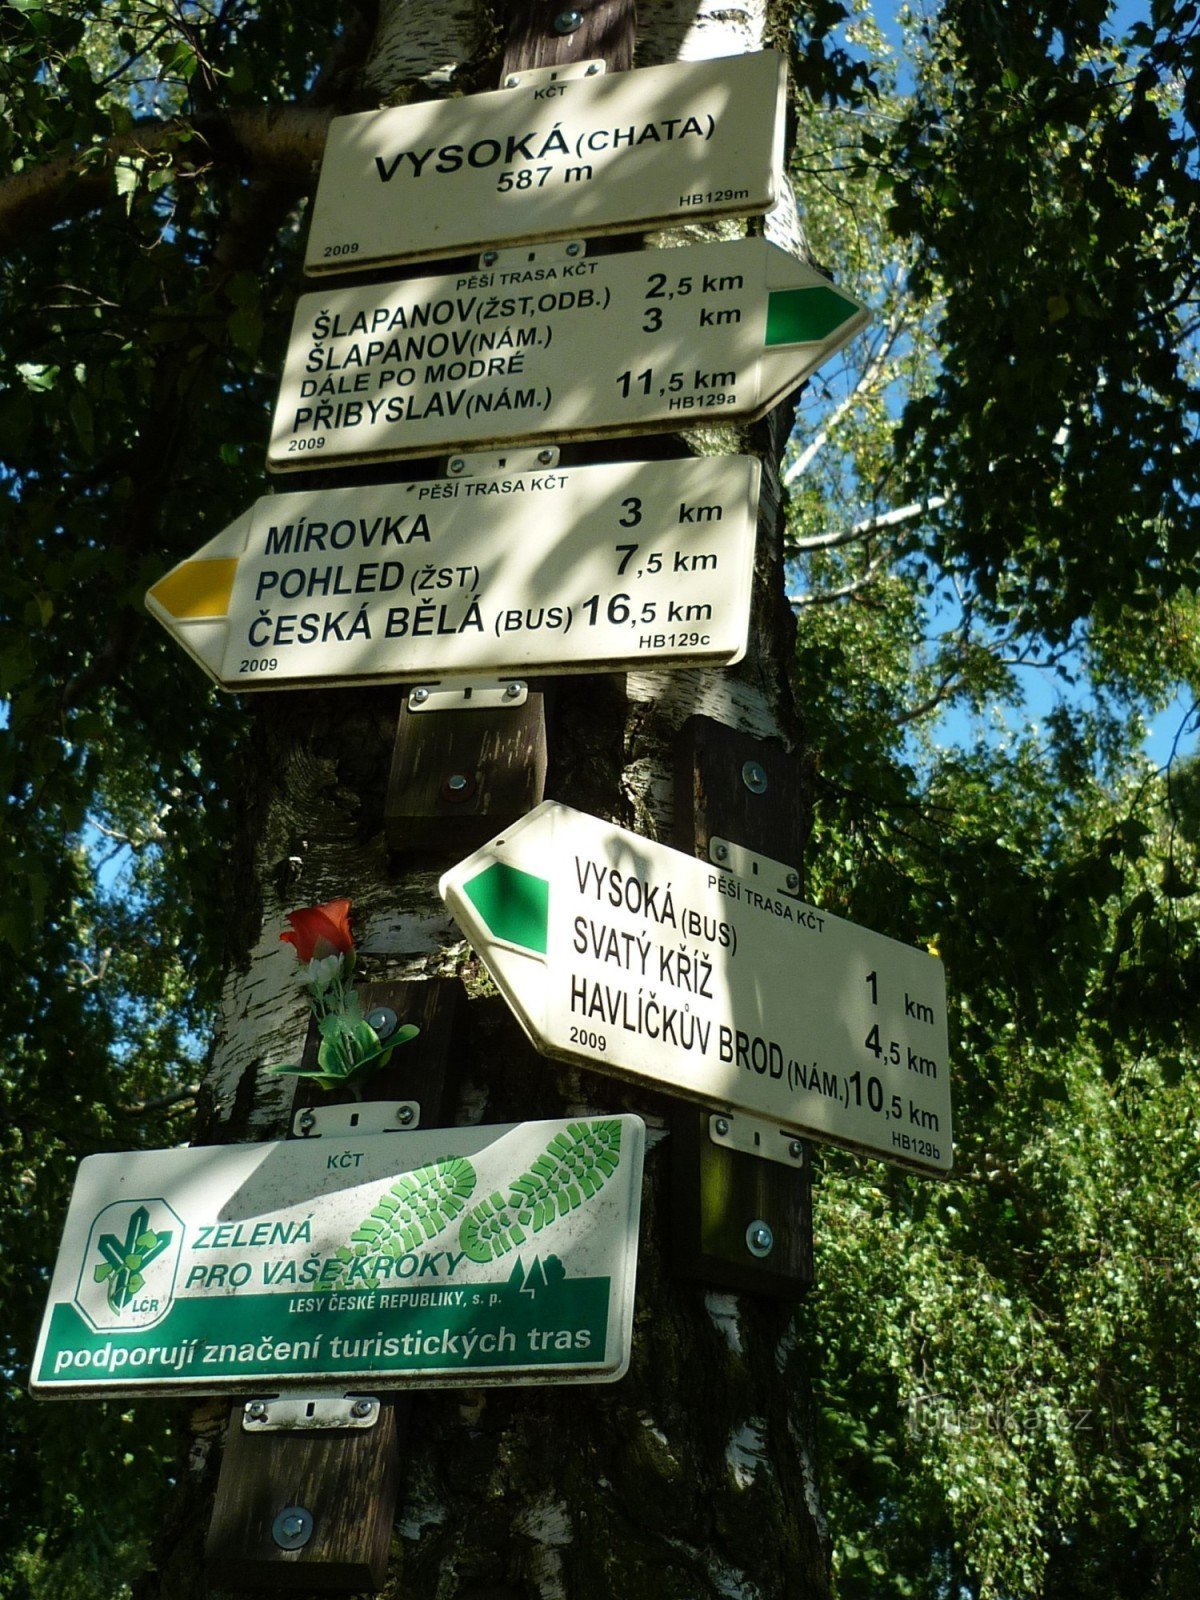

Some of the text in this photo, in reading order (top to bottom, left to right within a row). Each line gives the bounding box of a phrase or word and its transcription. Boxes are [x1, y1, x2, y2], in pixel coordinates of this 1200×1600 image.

[534, 85, 566, 100] KČT
[375, 122, 570, 183] VYSOKÁ
[497, 165, 592, 193] 587 m
[679, 188, 749, 207] HB129m
[324, 243, 359, 258] 2009
[456, 263, 598, 291] PĚŠÍ TRASA KČT
[645, 273, 743, 301] 2,5 km
[642, 307, 741, 333] 3 km
[300, 353, 525, 399] DÁLE PO MODRÉ
[616, 368, 736, 399] 11,5 km
[669, 393, 736, 411] HB129a
[288, 437, 325, 452] 2009
[418, 475, 569, 501] PĚŠÍ TRASA KČT
[618, 497, 723, 528] 3 km
[264, 513, 432, 556] MÍROVKA
[615, 543, 718, 579] 7,5 km
[255, 561, 480, 601] POHLED (ŽST)
[248, 594, 573, 648] ČESKÁ BĚLÁ (BUS)
[582, 592, 712, 628] 16,5 km
[638, 632, 711, 649] HB129c
[239, 658, 278, 673] 2009
[575, 855, 738, 957] VYSOKÁ (BUS)
[708, 874, 825, 933] PĚŠÍ TRASA KČT
[573, 916, 713, 999] SVATÝ KŘÍŽ
[865, 971, 934, 1025] 1 km
[570, 1026, 607, 1051] 2009
[571, 974, 711, 1055] HAVLÍČKŮV
[719, 1024, 784, 1080] BROD
[865, 1024, 937, 1079] 4,5 km
[849, 1070, 940, 1132] 10,5 km
[327, 1150, 364, 1169] KČT
[892, 1130, 941, 1160] HB129b
[191, 1213, 315, 1249] ZELENÁ
[184, 1251, 467, 1289] PRO VAŠE KROKY
[132, 1297, 159, 1313] LČR
[288, 1289, 502, 1314] LESY ČESKÉ REPUBLIKY, s. p.
[54, 1326, 592, 1374] podporují značení turistických tras
